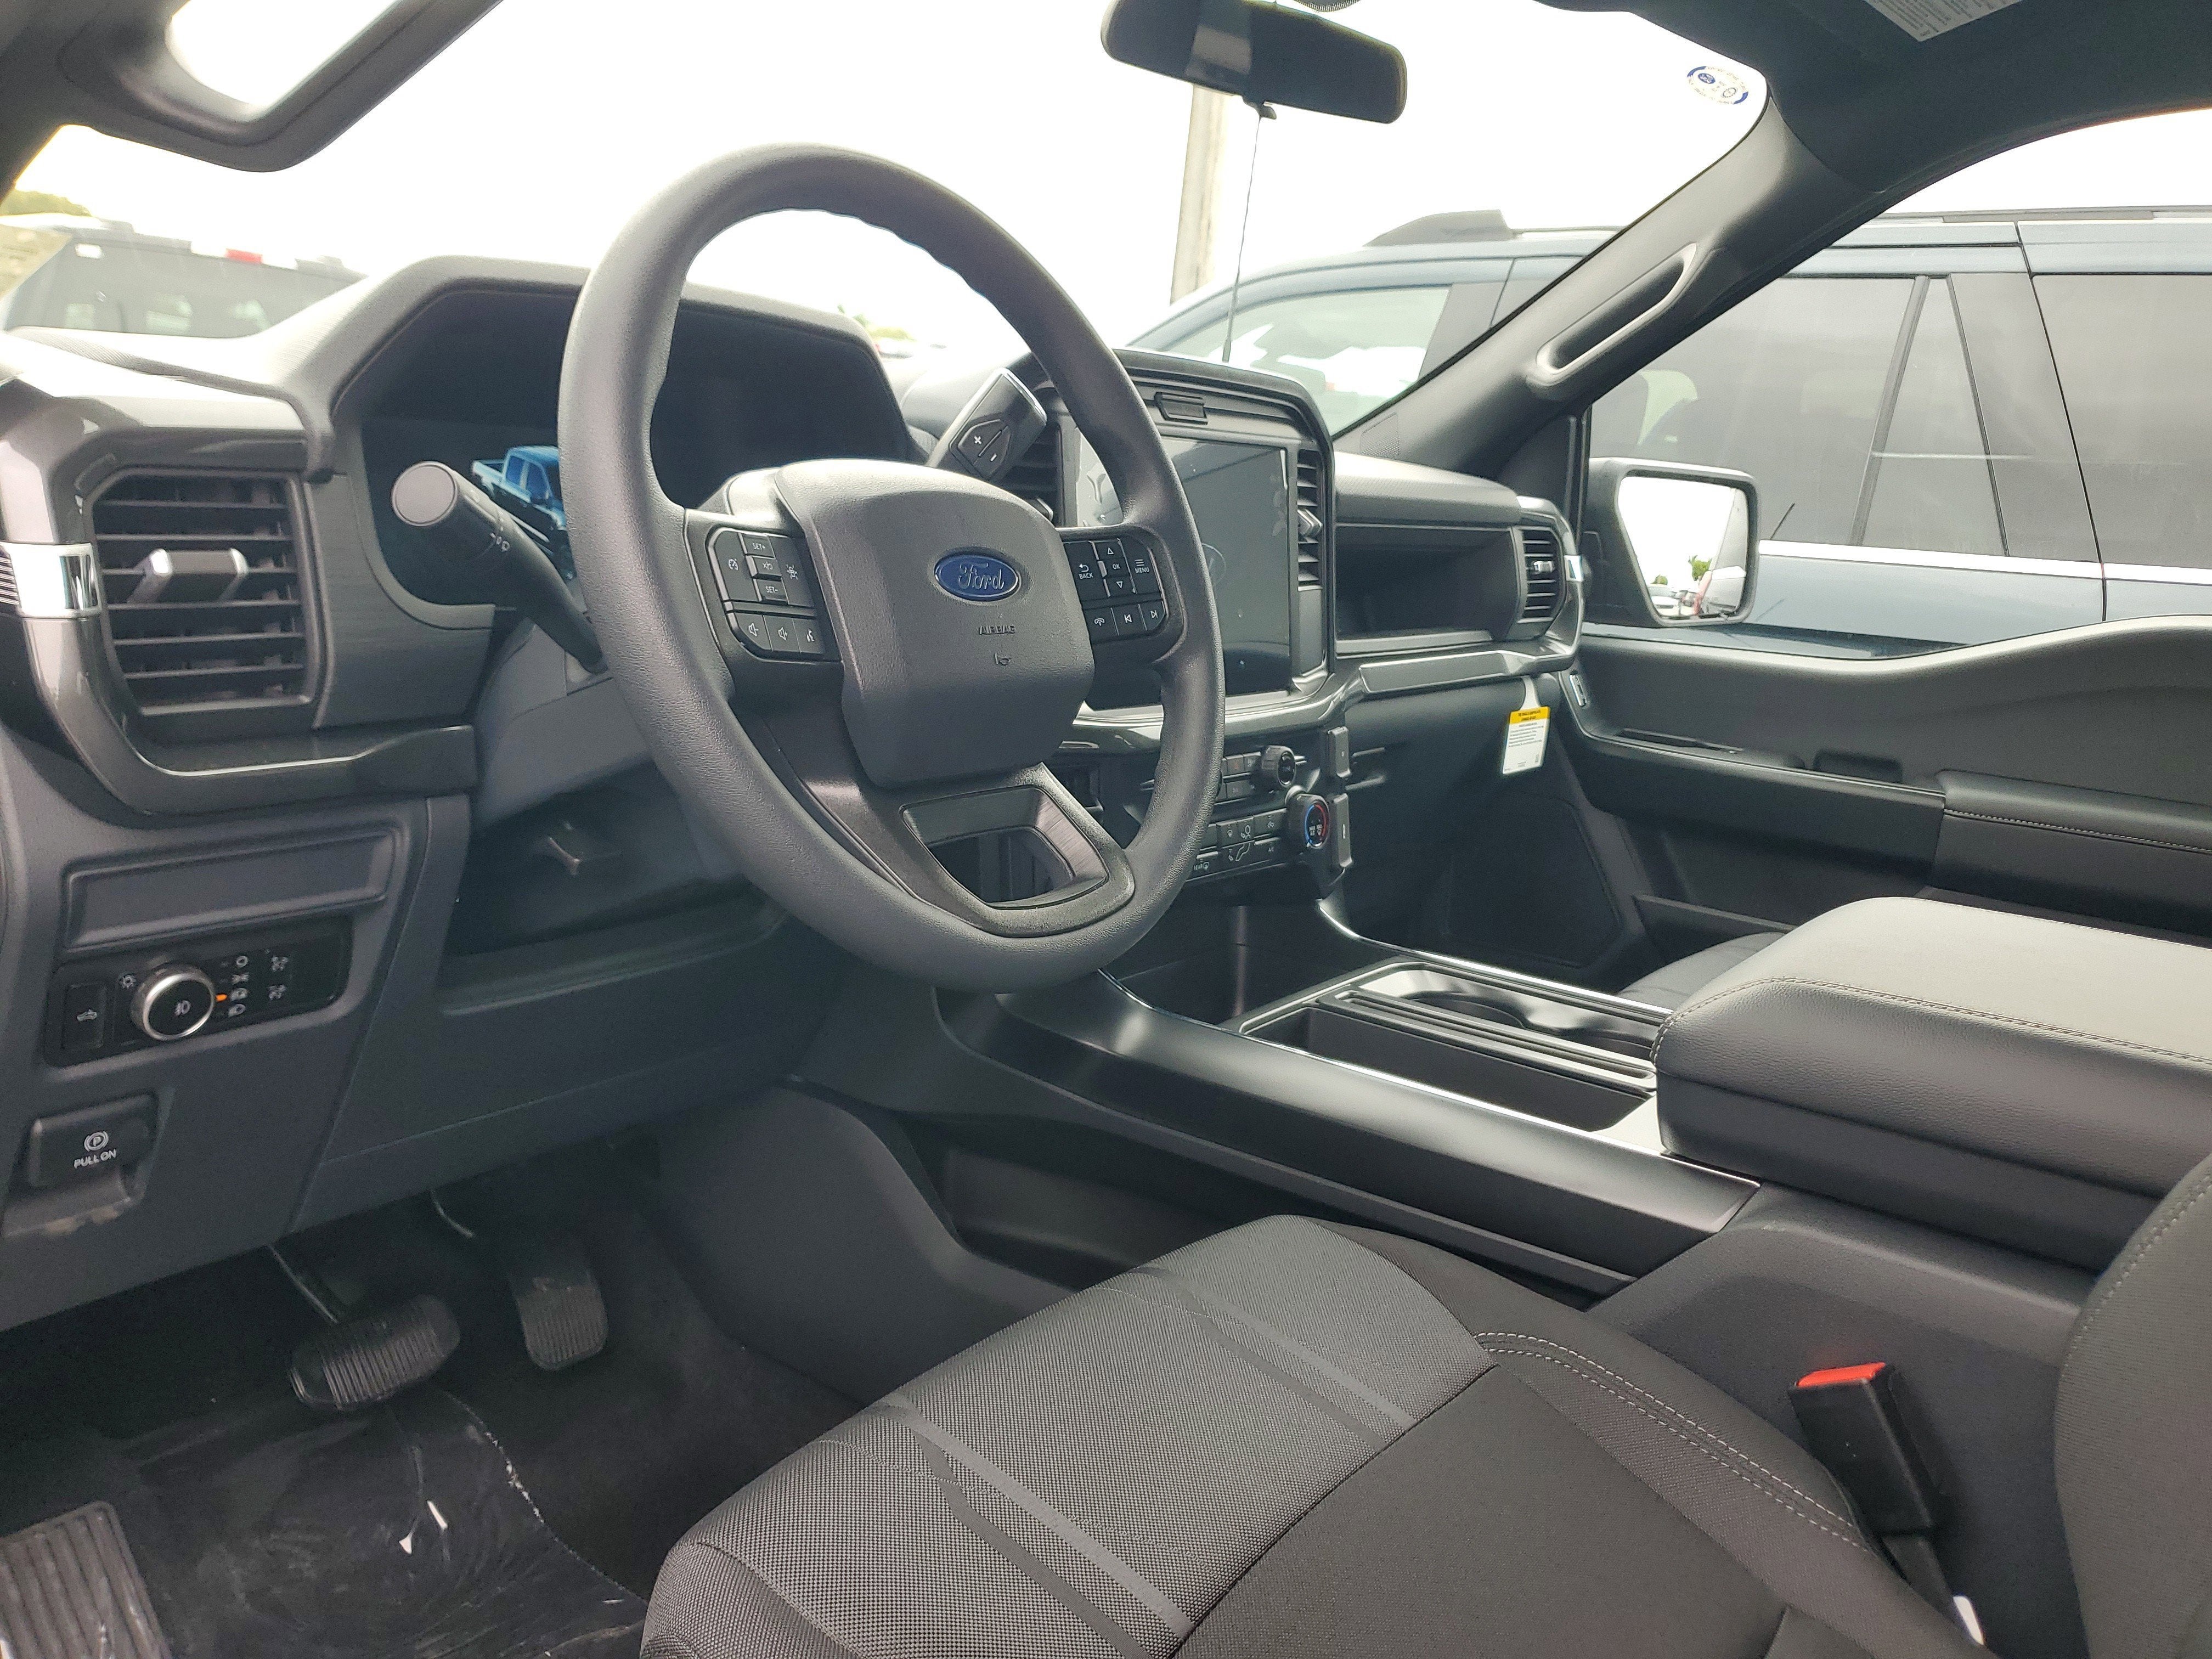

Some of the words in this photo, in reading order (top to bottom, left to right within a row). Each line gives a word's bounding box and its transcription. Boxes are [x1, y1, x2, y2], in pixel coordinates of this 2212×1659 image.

[958, 561, 1005, 590] Ford
[979, 624, 1016, 635] AIRBAG
[74, 1154, 100, 1169] PULL
[100, 1148, 117, 1161] ON
